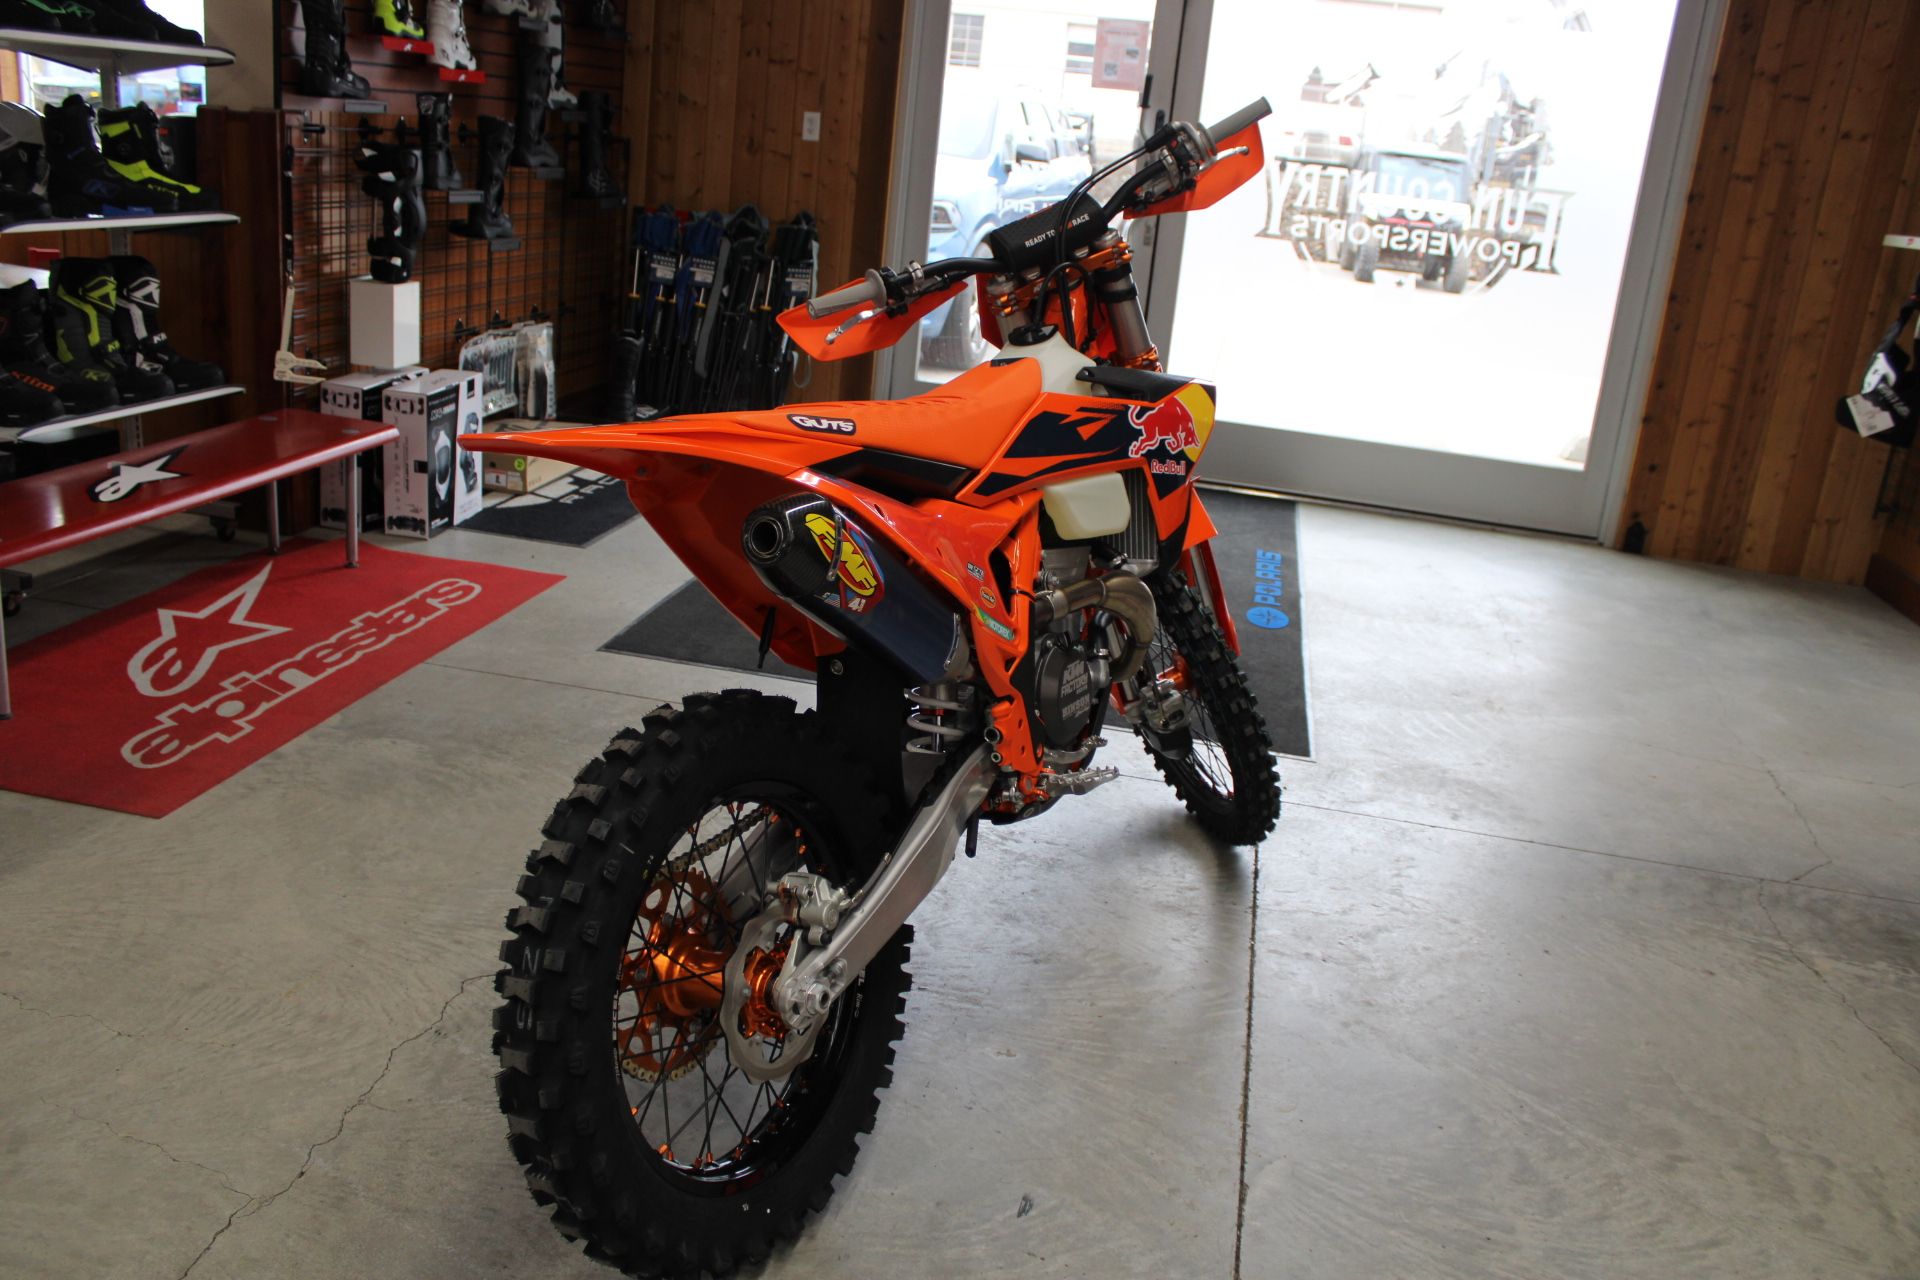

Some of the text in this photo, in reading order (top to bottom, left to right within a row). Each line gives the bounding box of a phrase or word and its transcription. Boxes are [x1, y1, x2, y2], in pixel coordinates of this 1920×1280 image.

[1024, 233, 1047, 248] READY
[1071, 213, 1090, 227] RACE
[792, 415, 854, 432] GUTS
[804, 515, 877, 590] FMF
[1253, 548, 1282, 606] POLARIS
[1063, 660, 1085, 685] KTM
